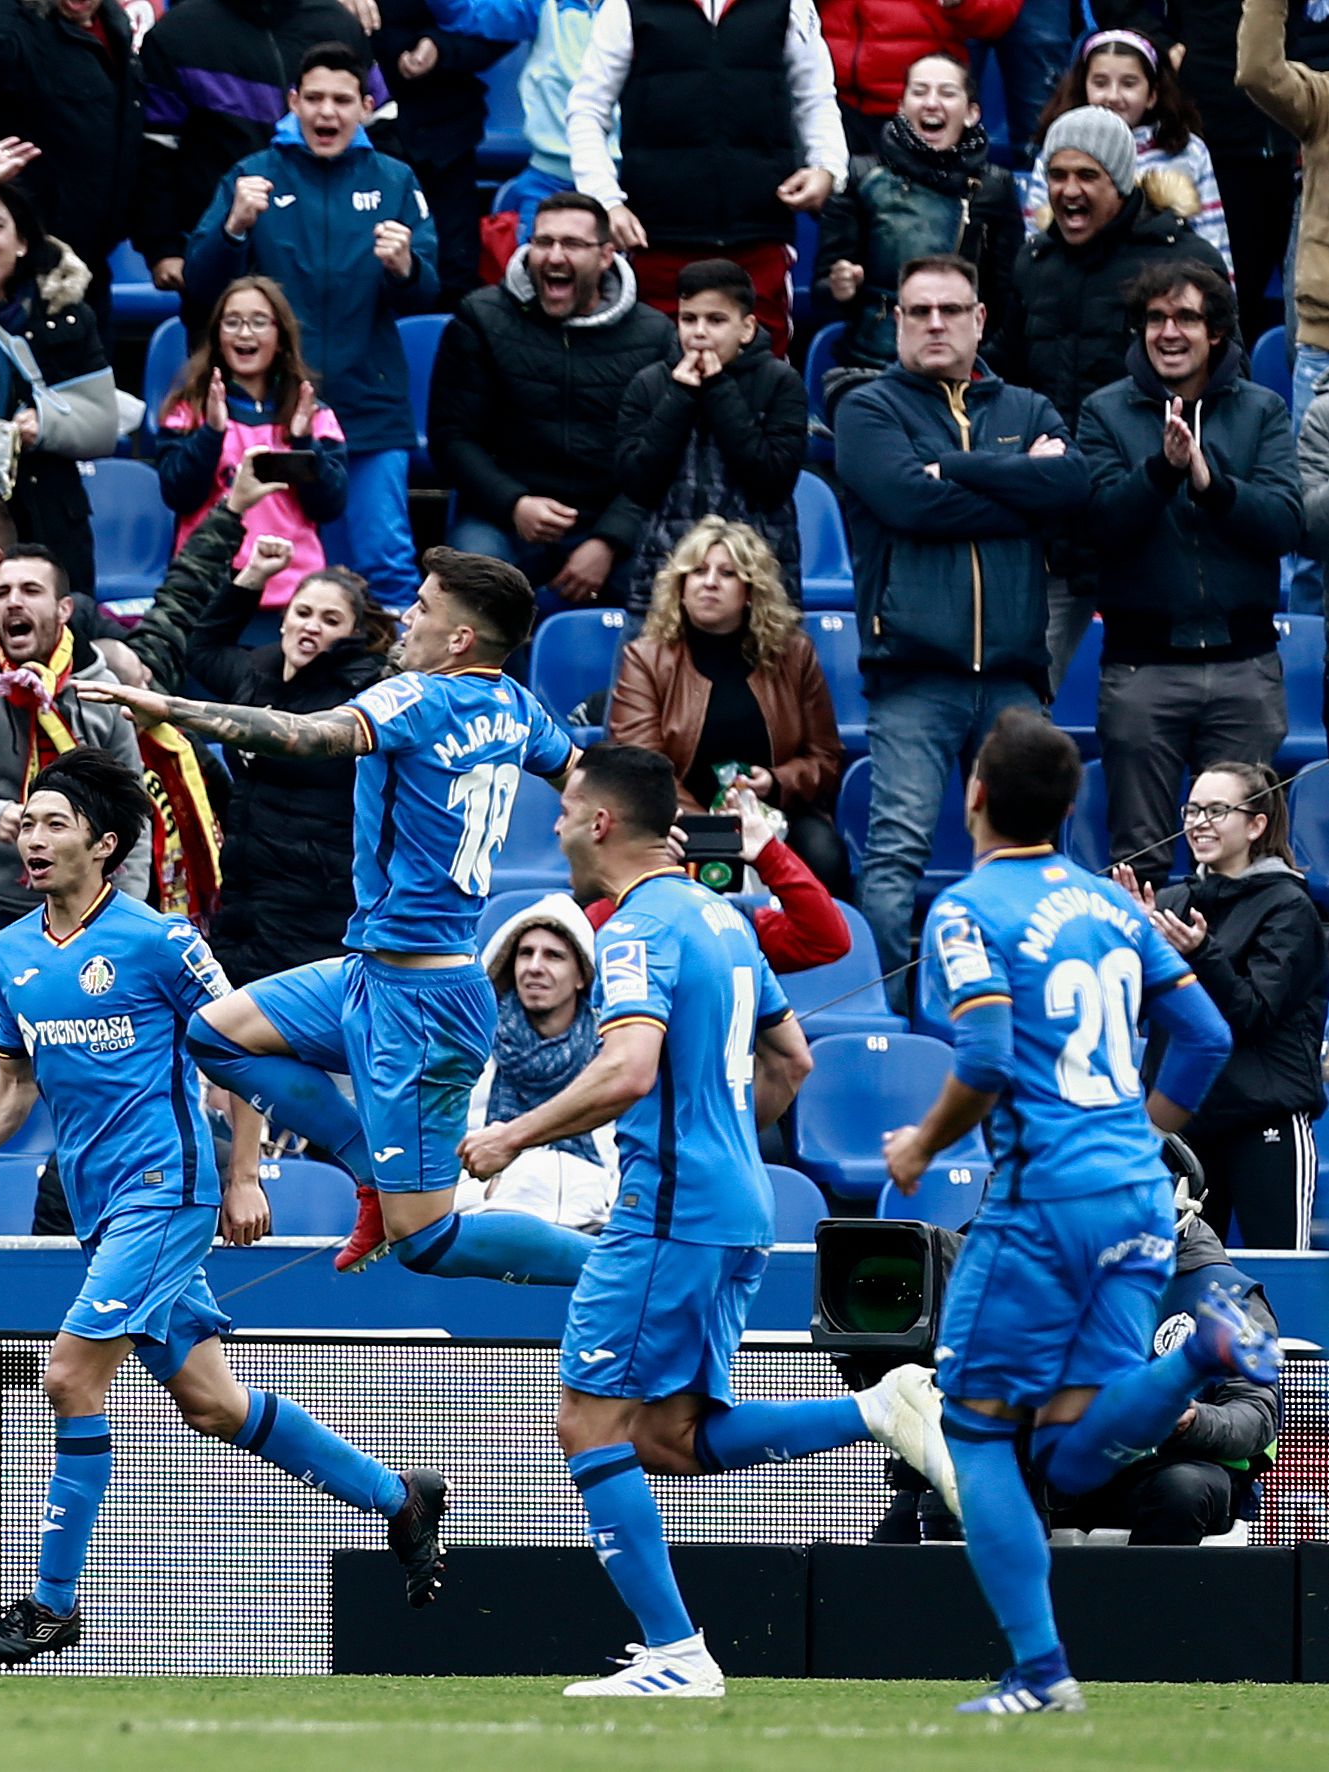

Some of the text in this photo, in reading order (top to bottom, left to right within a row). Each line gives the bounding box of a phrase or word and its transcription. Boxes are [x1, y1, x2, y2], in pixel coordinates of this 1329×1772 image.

[602, 611, 624, 628] 68
[820, 615, 843, 631] 69
[34, 1015, 135, 1046] TECNOCASA
[1045, 947, 1143, 1109] 20
[89, 1036, 137, 1053] GROUP
[725, 966, 755, 1112] 4
[866, 1036, 889, 1051] 68
[258, 1164, 281, 1180] 65
[948, 1168, 972, 1185] 68
